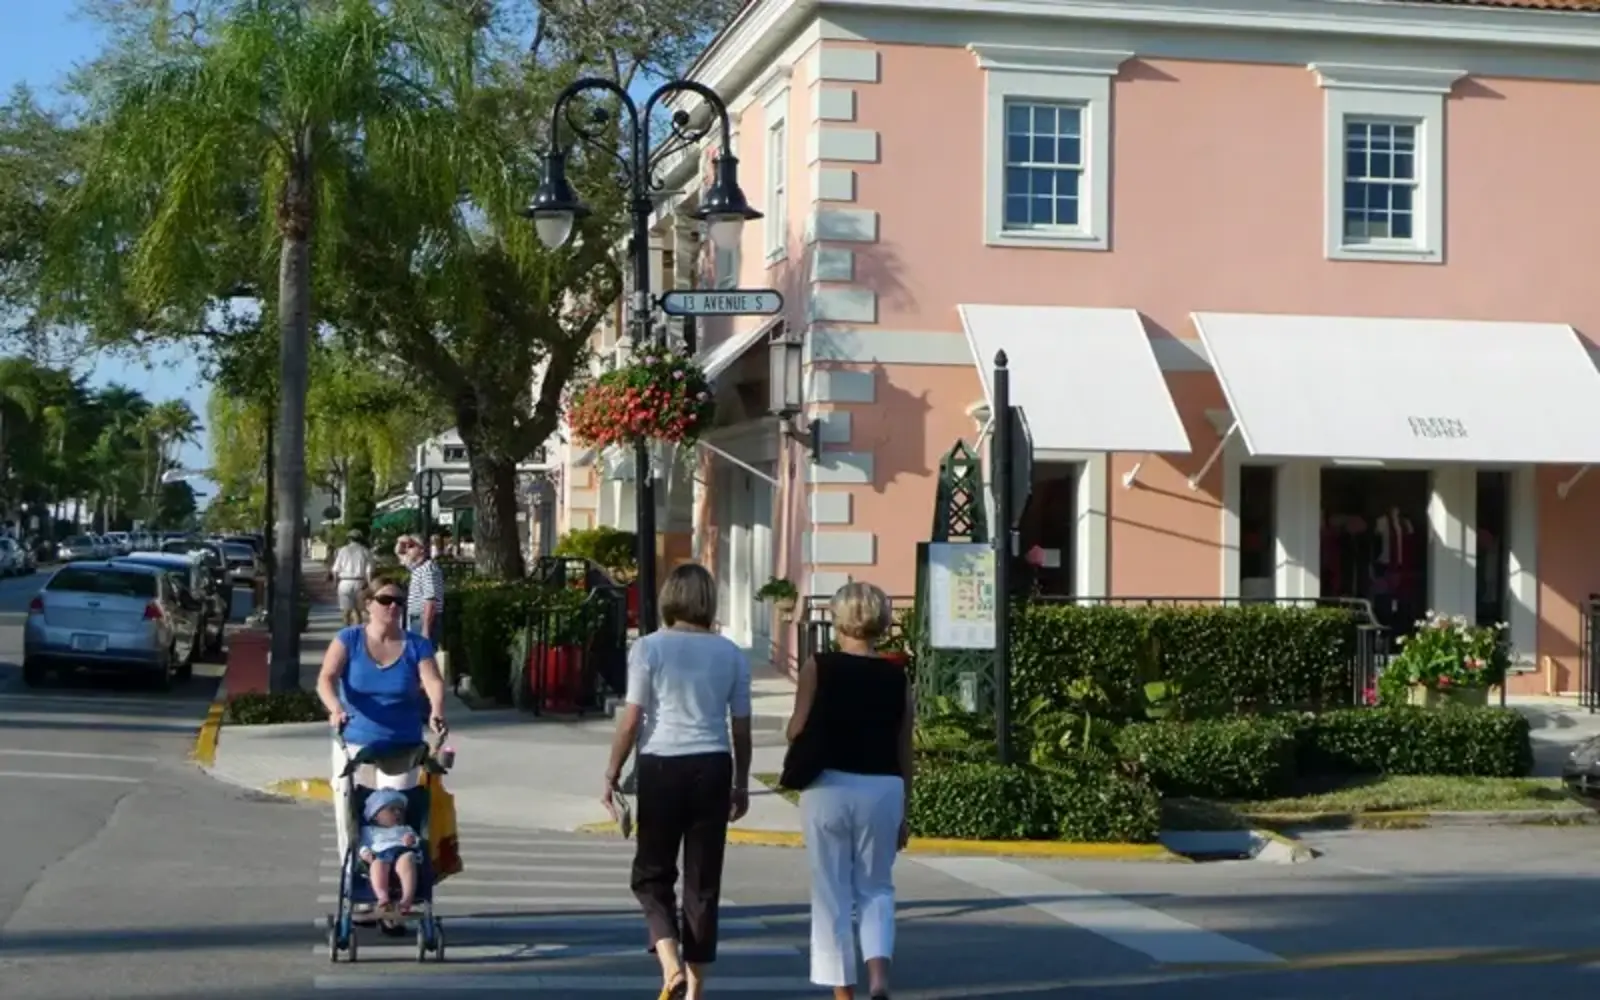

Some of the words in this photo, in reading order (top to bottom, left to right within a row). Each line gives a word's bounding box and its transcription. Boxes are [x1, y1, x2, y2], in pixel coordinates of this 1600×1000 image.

[683, 296, 695, 311] 13
[703, 295, 747, 311] AVENUE
[755, 295, 763, 310] S
[1412, 425, 1469, 438] FISHER
